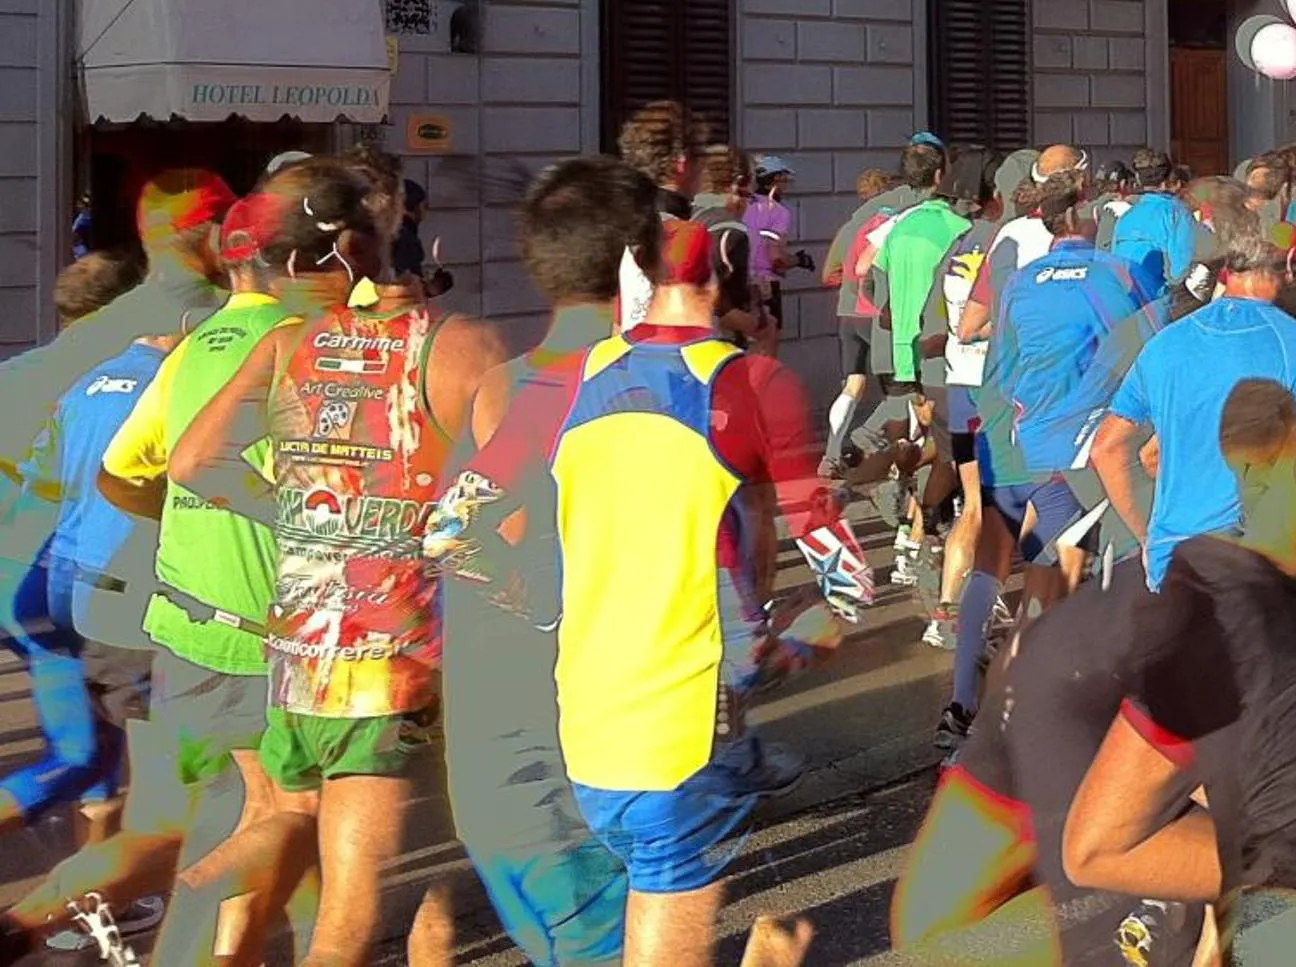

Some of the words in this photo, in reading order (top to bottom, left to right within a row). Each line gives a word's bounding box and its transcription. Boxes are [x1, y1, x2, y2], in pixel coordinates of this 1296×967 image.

[191, 85, 264, 105] HOTEL
[272, 86, 380, 107] LEOPOLDA
[313, 332, 406, 352] Carmine
[311, 442, 328, 455] DE
[330, 444, 393, 461] MATTEIS
